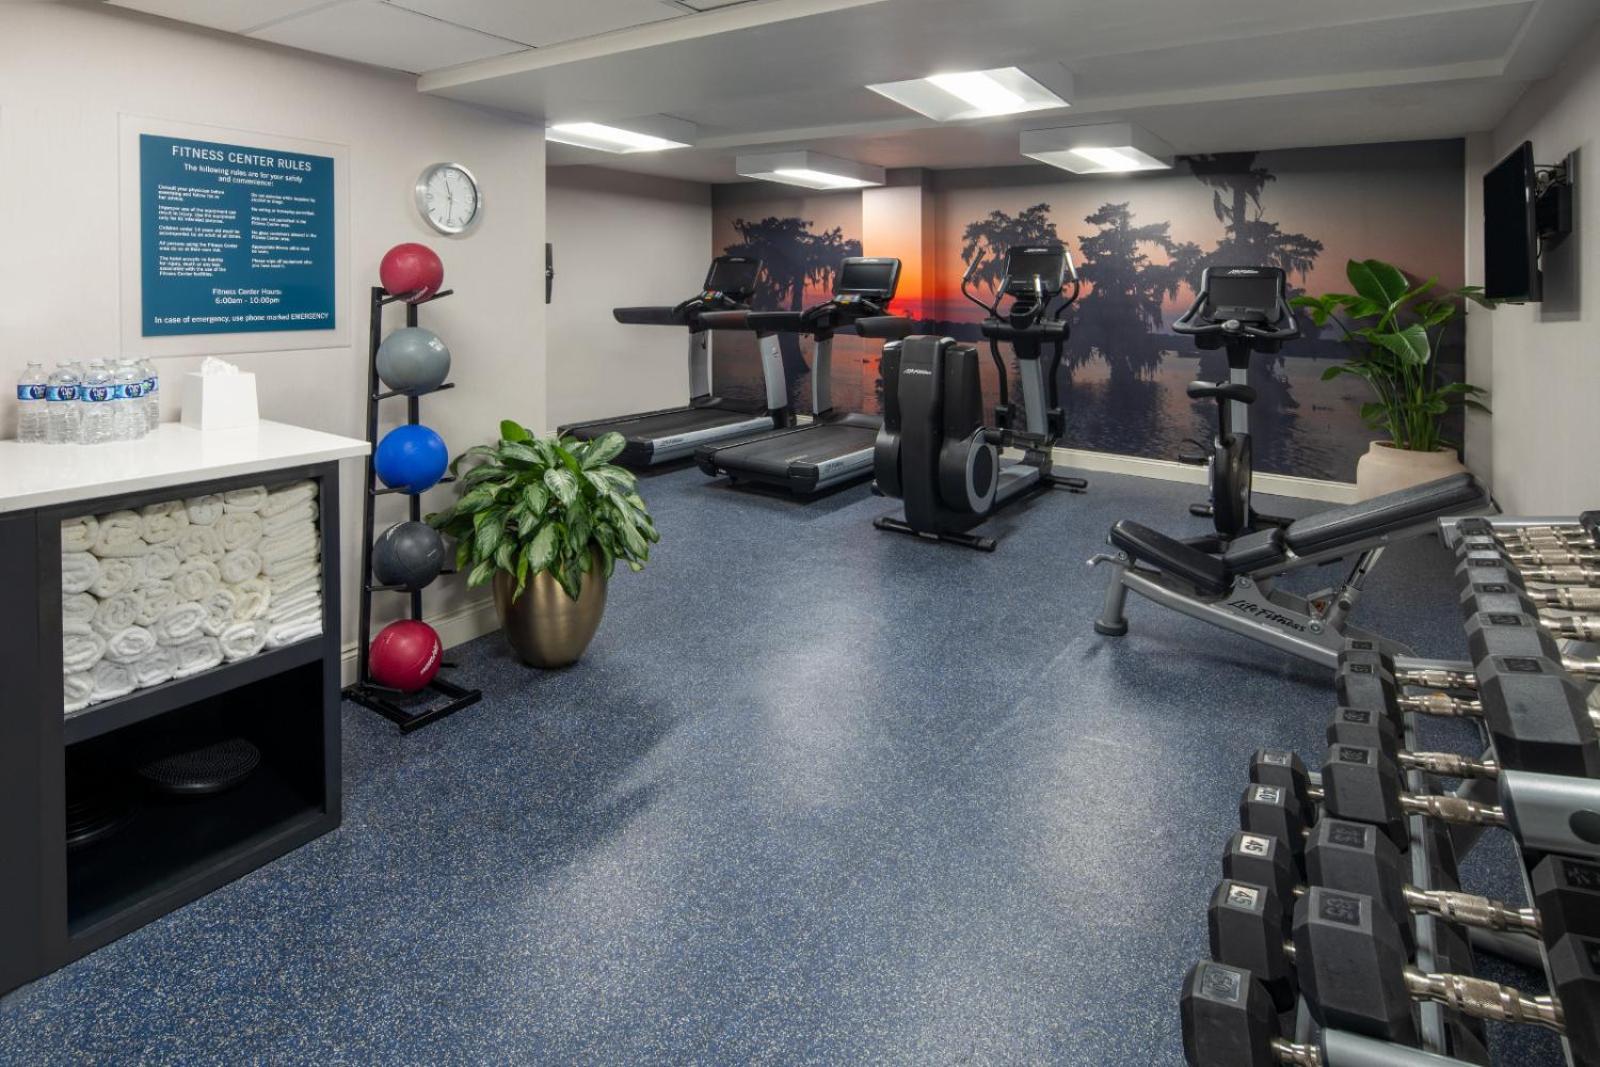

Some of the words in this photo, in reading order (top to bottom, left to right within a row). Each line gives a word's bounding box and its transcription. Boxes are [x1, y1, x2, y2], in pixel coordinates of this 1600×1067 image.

[172, 145, 224, 161] FITNESS
[228, 152, 274, 167] CENTER
[277, 158, 312, 172] RULES
[184, 163, 198, 171] The
[199, 165, 229, 176] following
[285, 174, 303, 183] safety
[154, 316, 162, 324] In
[192, 316, 231, 325] emergency,
[245, 314, 265, 322] phone
[266, 313, 290, 321] marked
[290, 312, 329, 320] EMERGENCY
[1255, 608, 1306, 632] Fitness
[1244, 840, 1263, 854] 45
[1233, 889, 1252, 905] 45
